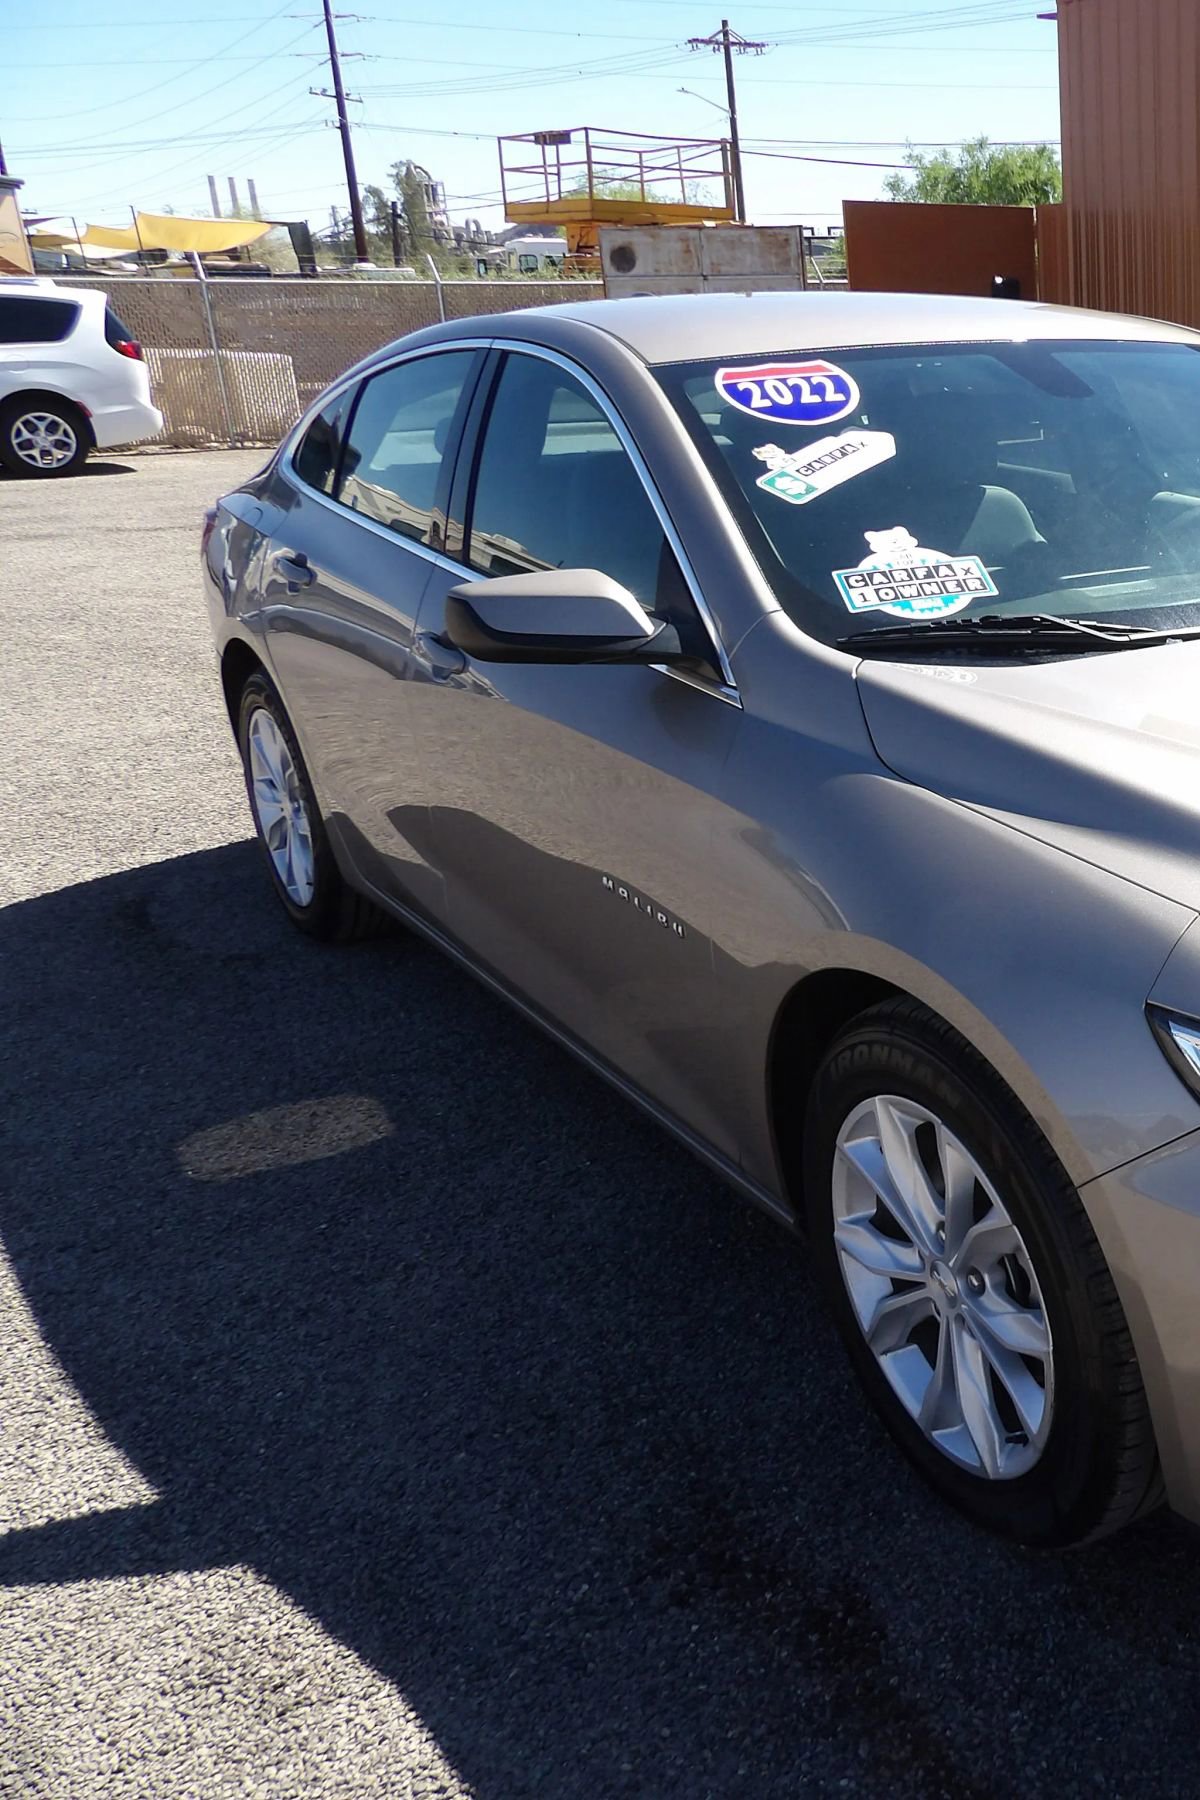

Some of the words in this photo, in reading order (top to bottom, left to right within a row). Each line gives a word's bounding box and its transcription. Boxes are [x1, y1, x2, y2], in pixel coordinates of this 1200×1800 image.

[737, 375, 846, 410] 2022
[844, 564, 975, 589] CARFAX
[857, 592, 868, 603] 1
[874, 577, 988, 603] OWNER
[602, 876, 685, 938] MALIBU
